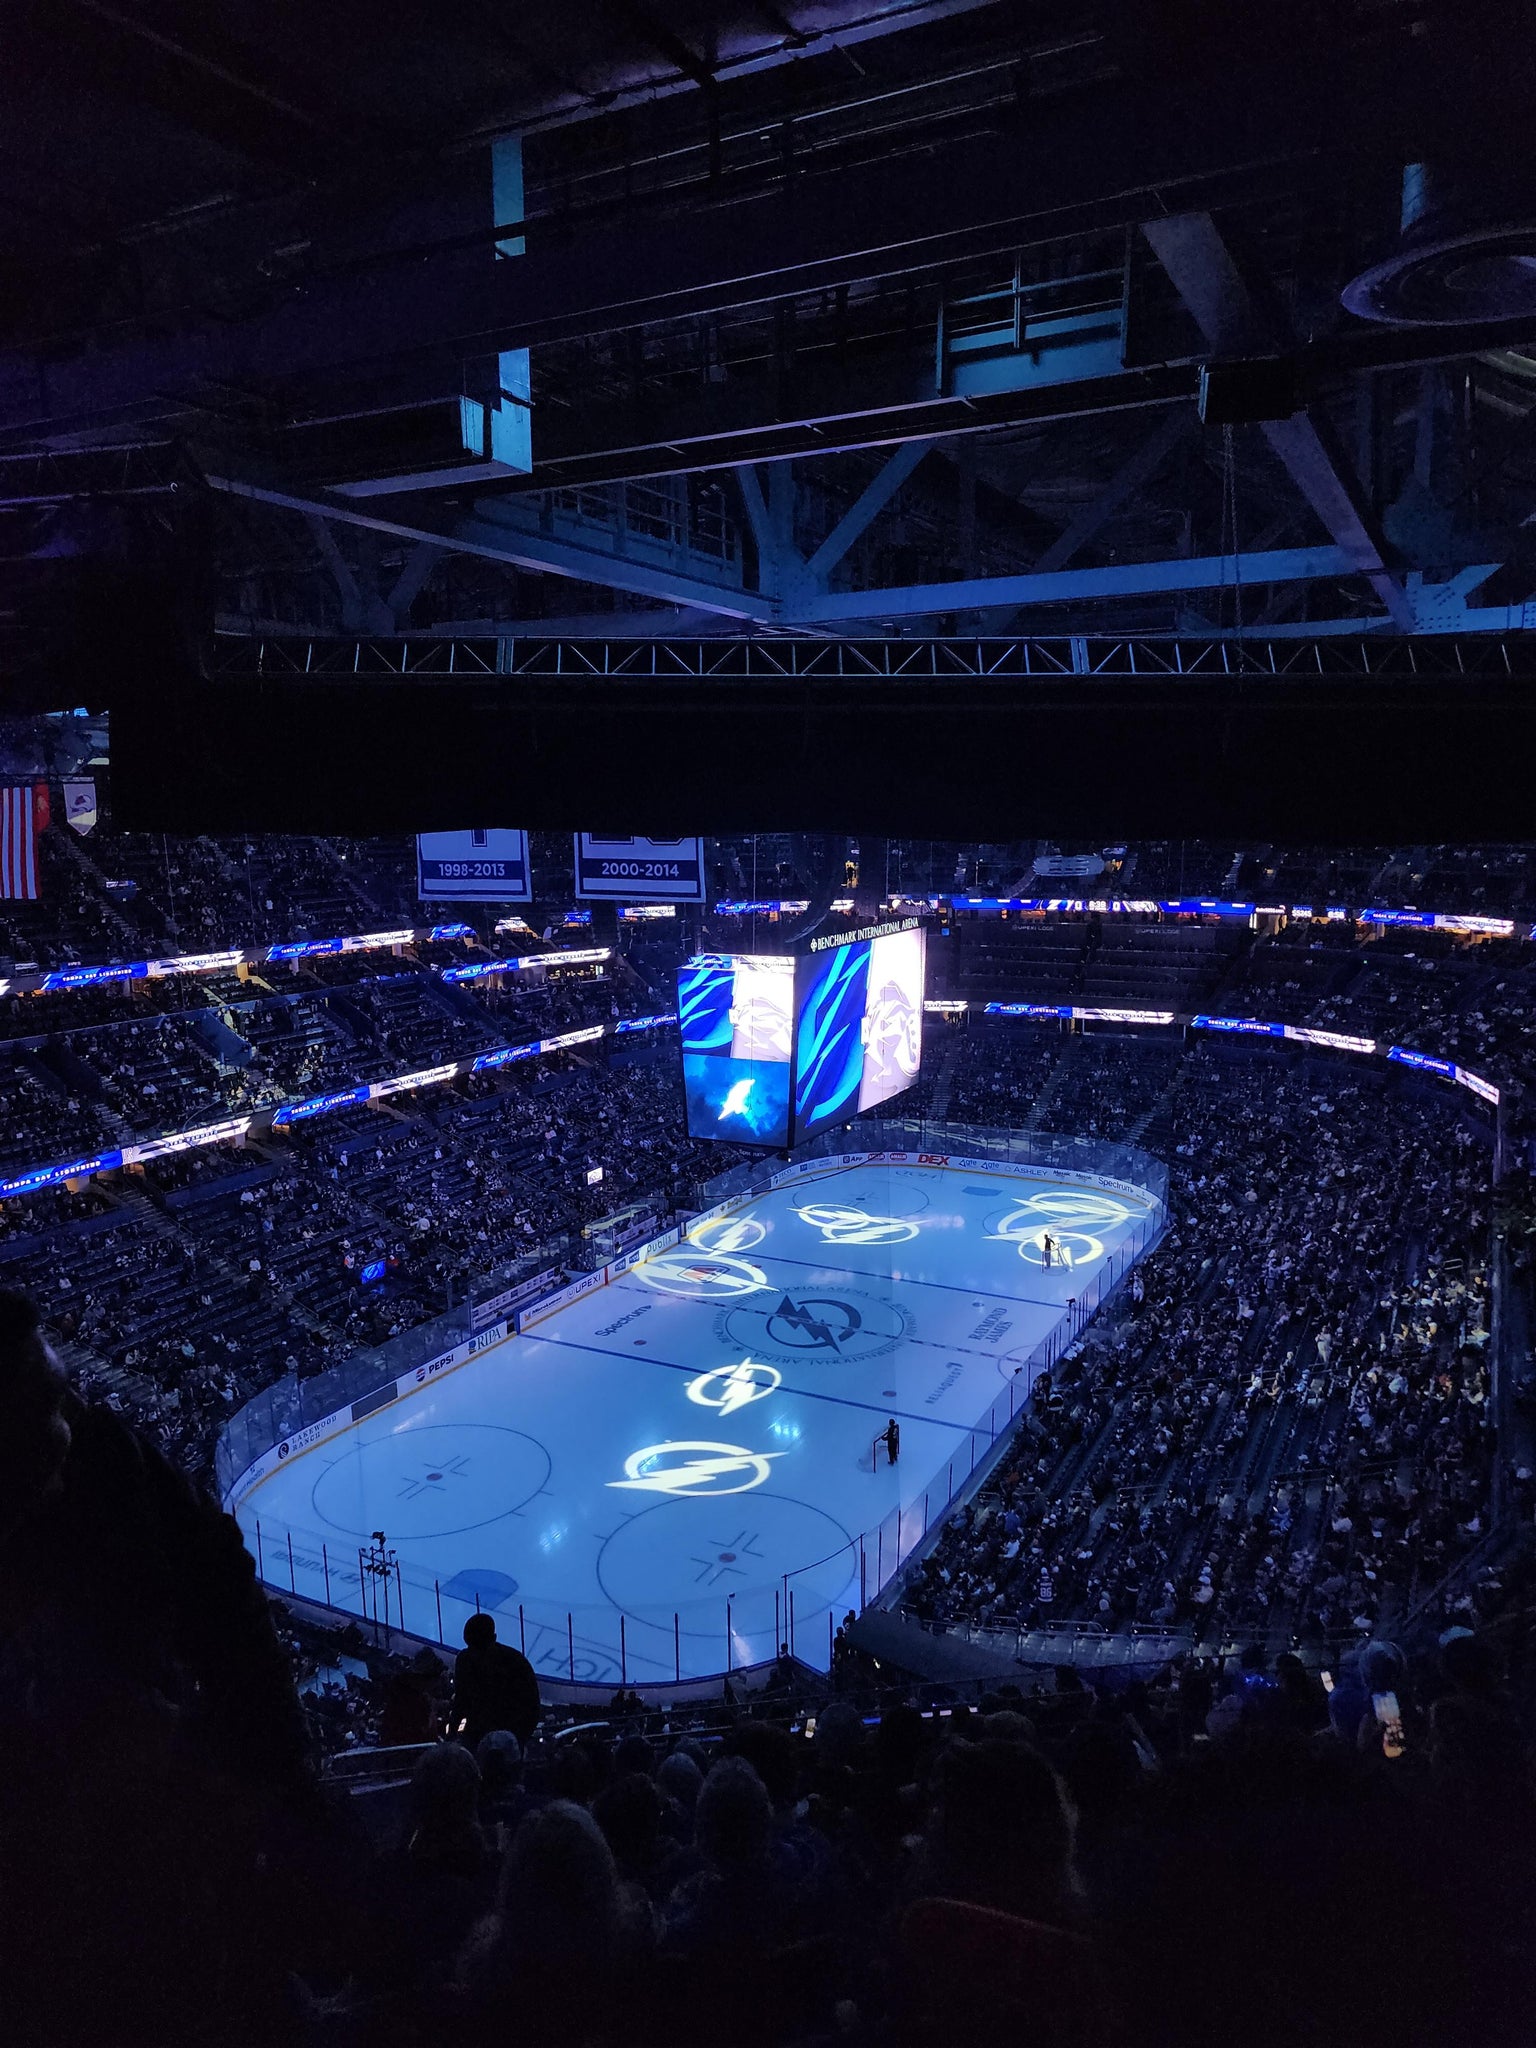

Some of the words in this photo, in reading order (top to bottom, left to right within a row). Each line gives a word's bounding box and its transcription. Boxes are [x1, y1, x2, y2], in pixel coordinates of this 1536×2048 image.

[438, 863, 505, 878] 1998-2013
[601, 861, 680, 878] 2000-2014
[817, 930, 857, 951] BENCHMARK
[857, 920, 901, 942] INTERNATIONAL
[901, 917, 919, 932] ARENA
[918, 1153, 950, 1166] DEX
[2, 1179, 31, 1191] TAMPA
[35, 1174, 51, 1182] BAY
[54, 1160, 101, 1177] LIGHTNING
[1013, 1166, 1048, 1177] ASHLEY
[1098, 1176, 1131, 1193] Spectrum
[646, 1235, 672, 1255] Publix
[575, 1273, 601, 1295] UPEXI
[595, 1305, 650, 1337] Spectrum
[968, 1307, 1008, 1341] RAYMOND
[477, 1327, 502, 1351] RIPA
[428, 1353, 455, 1375] PEPSI
[291, 1415, 337, 1444] LAKEWOOD
[292, 1431, 321, 1452] RANCH
